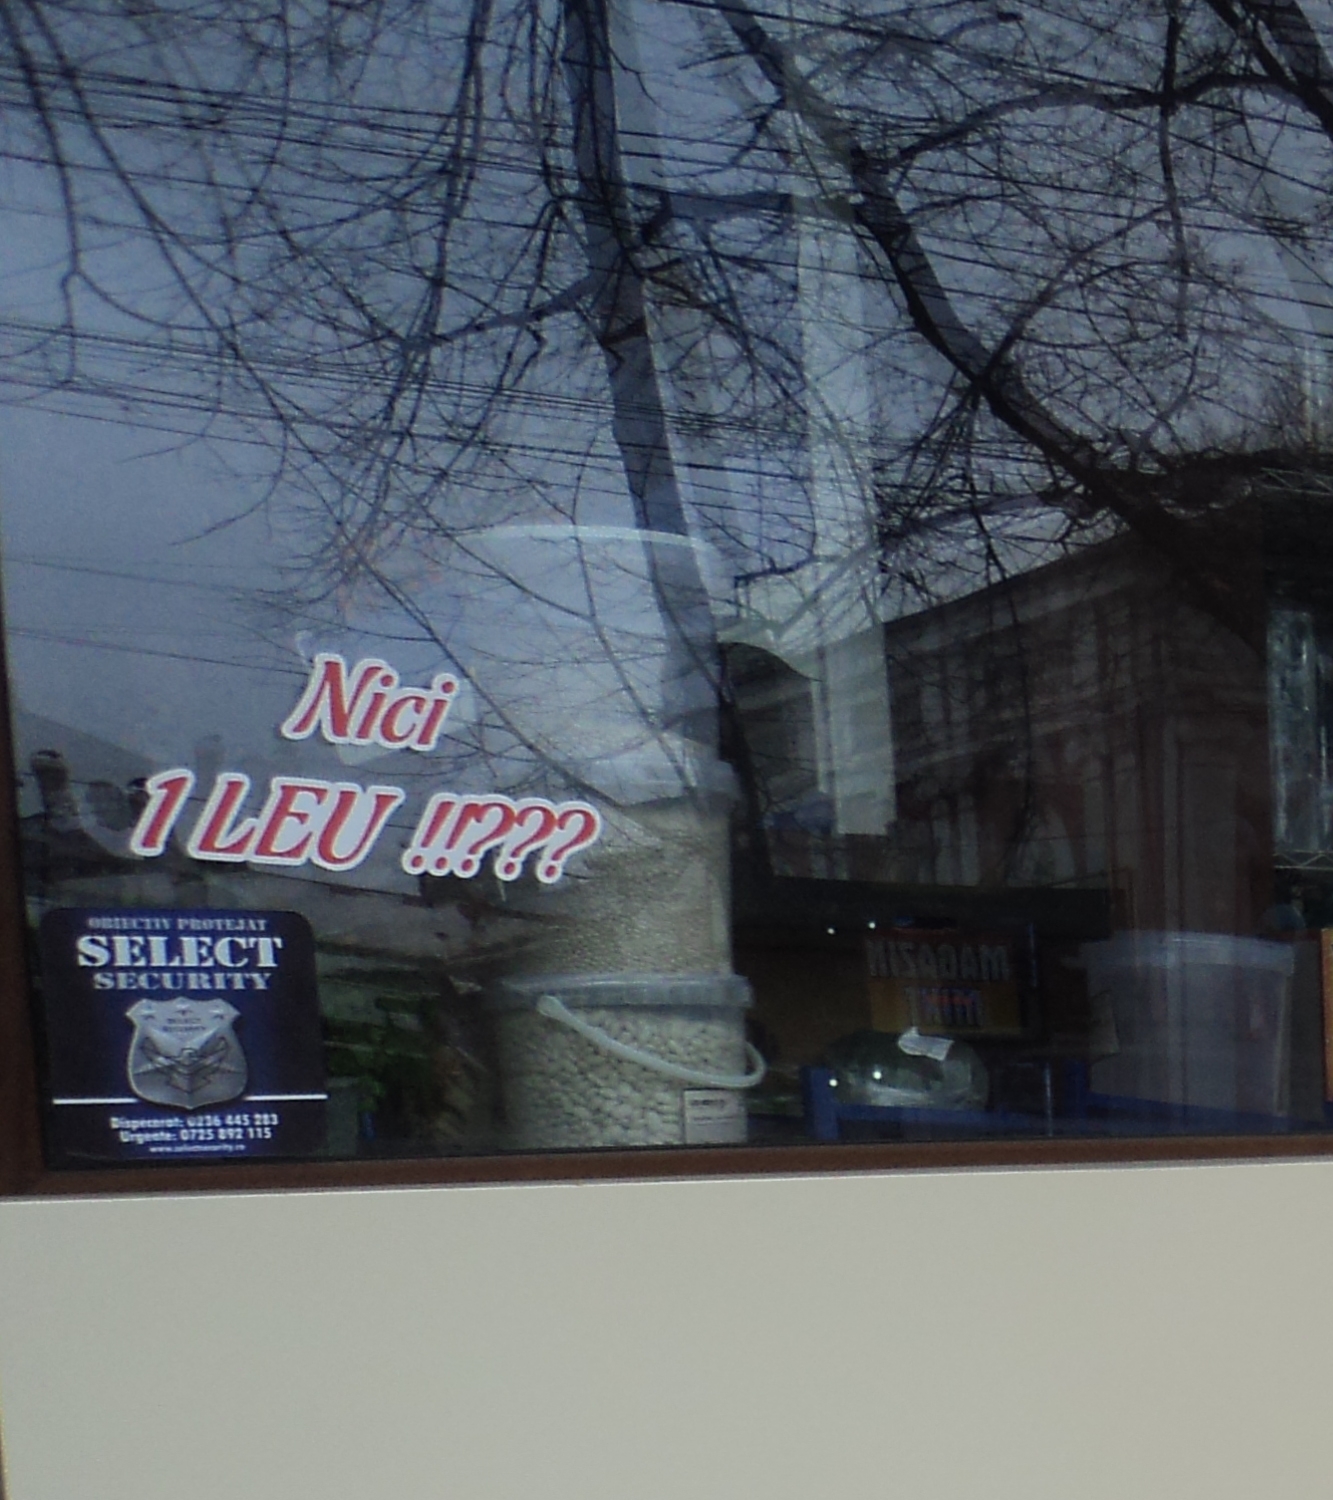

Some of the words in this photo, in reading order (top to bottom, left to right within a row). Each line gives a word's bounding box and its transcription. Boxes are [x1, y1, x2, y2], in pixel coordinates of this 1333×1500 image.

[282, 653, 461, 751] Nici
[131, 769, 195, 857] 1
[187, 773, 405, 871] LEU
[403, 793, 601, 884] !!???
[177, 918, 267, 931] PROTEJAT
[77, 935, 283, 968] SELECT
[94, 971, 272, 990] SECURITY
[248, 1127, 272, 1139] 115
